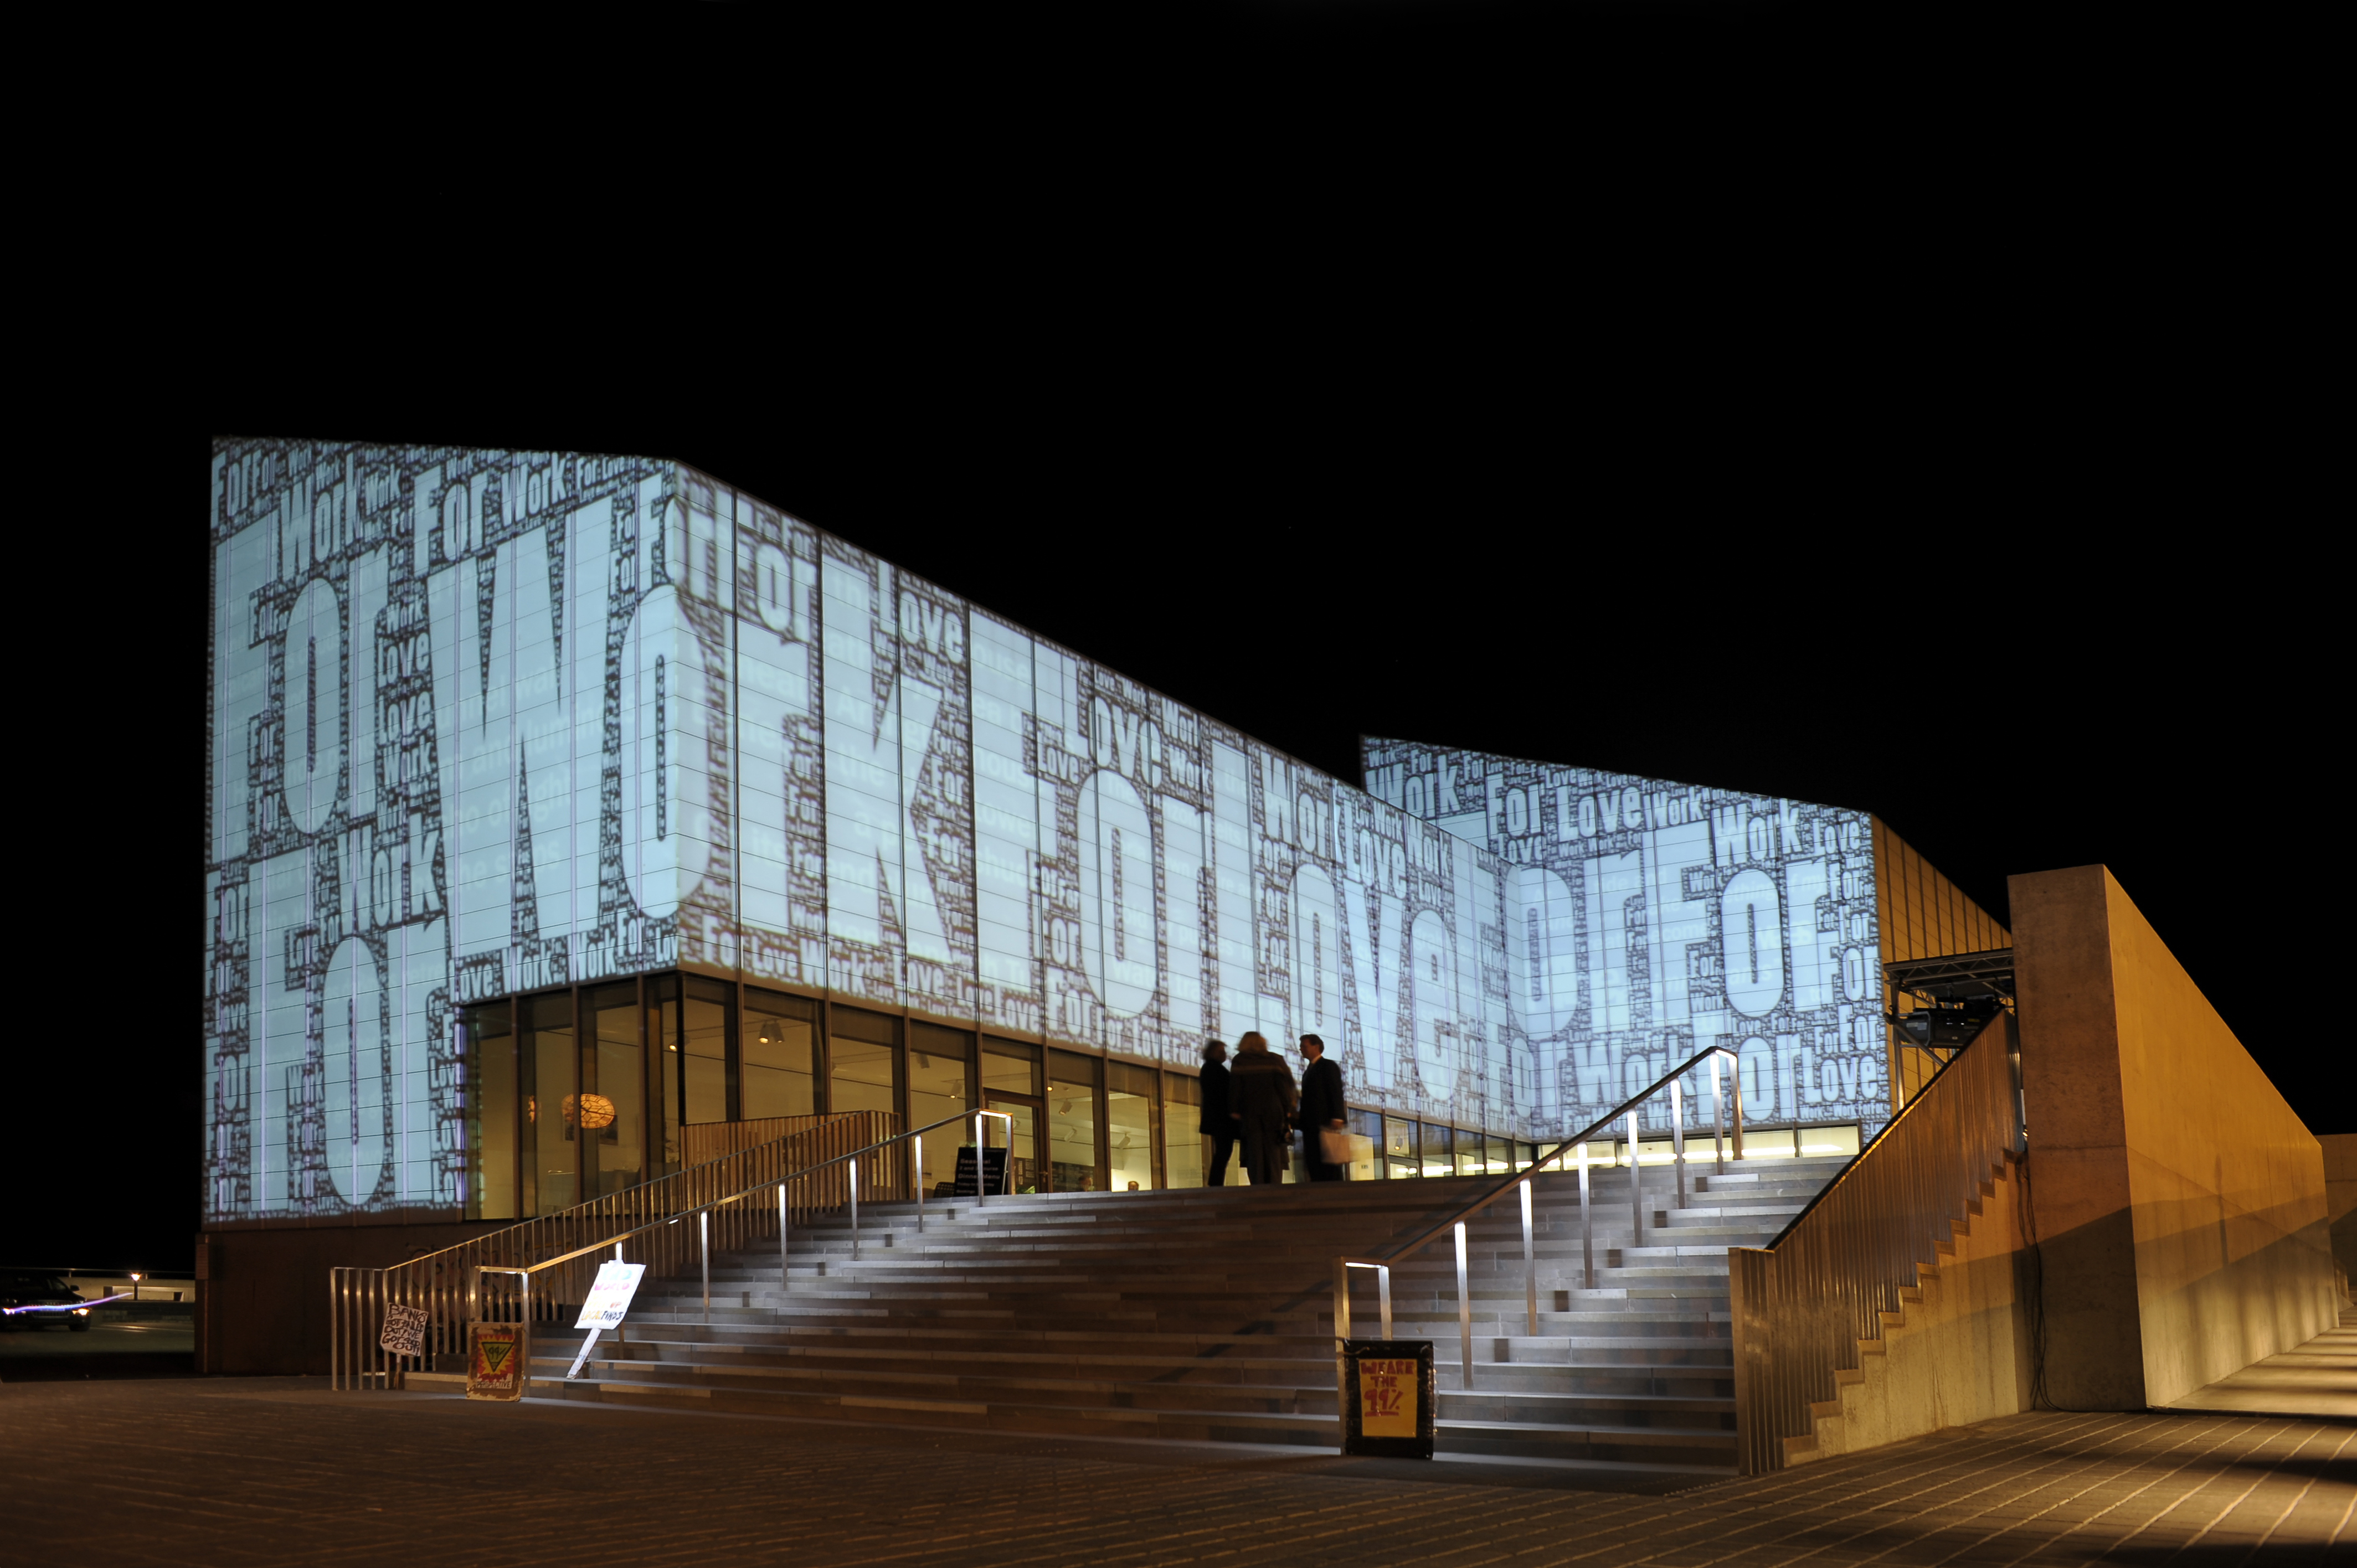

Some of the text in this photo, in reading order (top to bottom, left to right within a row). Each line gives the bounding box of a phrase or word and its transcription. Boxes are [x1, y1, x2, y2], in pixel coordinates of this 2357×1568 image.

[365, 462, 402, 516] Work
[501, 451, 567, 527] Work
[281, 450, 362, 583] Work
[414, 464, 488, 579] For
[878, 559, 964, 665] Love
[378, 632, 430, 688] Love
[213, 506, 389, 865] For
[378, 692, 431, 745] Love
[1063, 655, 1162, 788] Love
[931, 754, 965, 806] For
[1038, 731, 1079, 784] Love
[1368, 747, 1396, 767] Work
[1411, 749, 1432, 774] For
[1463, 754, 1484, 781] For
[1546, 768, 1576, 788] Love
[1607, 773, 1628, 788] Love
[1260, 750, 1351, 864] Work
[1366, 754, 1460, 819] Work
[1487, 773, 1541, 839] For
[1643, 786, 1704, 831] Work
[970, 610, 1214, 1035] For
[1374, 801, 1403, 844] Work
[1556, 786, 1642, 843] Love
[1712, 798, 1802, 868] Work
[1813, 818, 1860, 857] Love
[1344, 800, 1407, 899] Love
[1406, 813, 1450, 879] Work
[1497, 832, 1543, 864] Love
[1559, 840, 1584, 858] Work
[337, 812, 441, 937] Work
[1255, 871, 1282, 921] For
[1829, 863, 1860, 901] For
[205, 870, 249, 946] For
[1032, 893, 1080, 969] For
[1626, 908, 1646, 926] For
[1643, 822, 1827, 1025] For
[1816, 909, 1836, 930] For
[1839, 905, 1870, 943] For
[567, 929, 617, 984] Work
[752, 936, 798, 978] Love
[1259, 921, 1288, 969] For
[1452, 835, 1640, 1038] For
[1628, 931, 1647, 952] For
[449, 958, 493, 1003] Love
[502, 937, 552, 993] Work
[800, 938, 867, 996] Work
[893, 946, 944, 997] Love
[1690, 950, 1716, 978] For
[1817, 930, 1878, 1004] For
[957, 974, 994, 1012] Love
[995, 986, 1040, 1034] Love
[1046, 967, 1093, 1039] For
[1691, 992, 1725, 1013] Work
[249, 847, 445, 1213] For
[1133, 1018, 1170, 1064] Love
[1732, 1018, 1761, 1036] Love
[1815, 1026, 1839, 1055] For
[1838, 1004, 1878, 1053] For
[206, 1038, 249, 1112] For
[1573, 1034, 1697, 1105] Work
[1802, 1046, 1878, 1103] Love
[1800, 1105, 1823, 1119] Work
[209, 1166, 238, 1213] For
[388, 1303, 428, 1323] BANKS
[581, 1310, 603, 1321] LOCAL
[382, 1333, 404, 1344] GOT
[1371, 1376, 1397, 1388] THE
[1387, 1360, 1414, 1375] ARE
[1364, 1389, 1403, 1410] 99%
